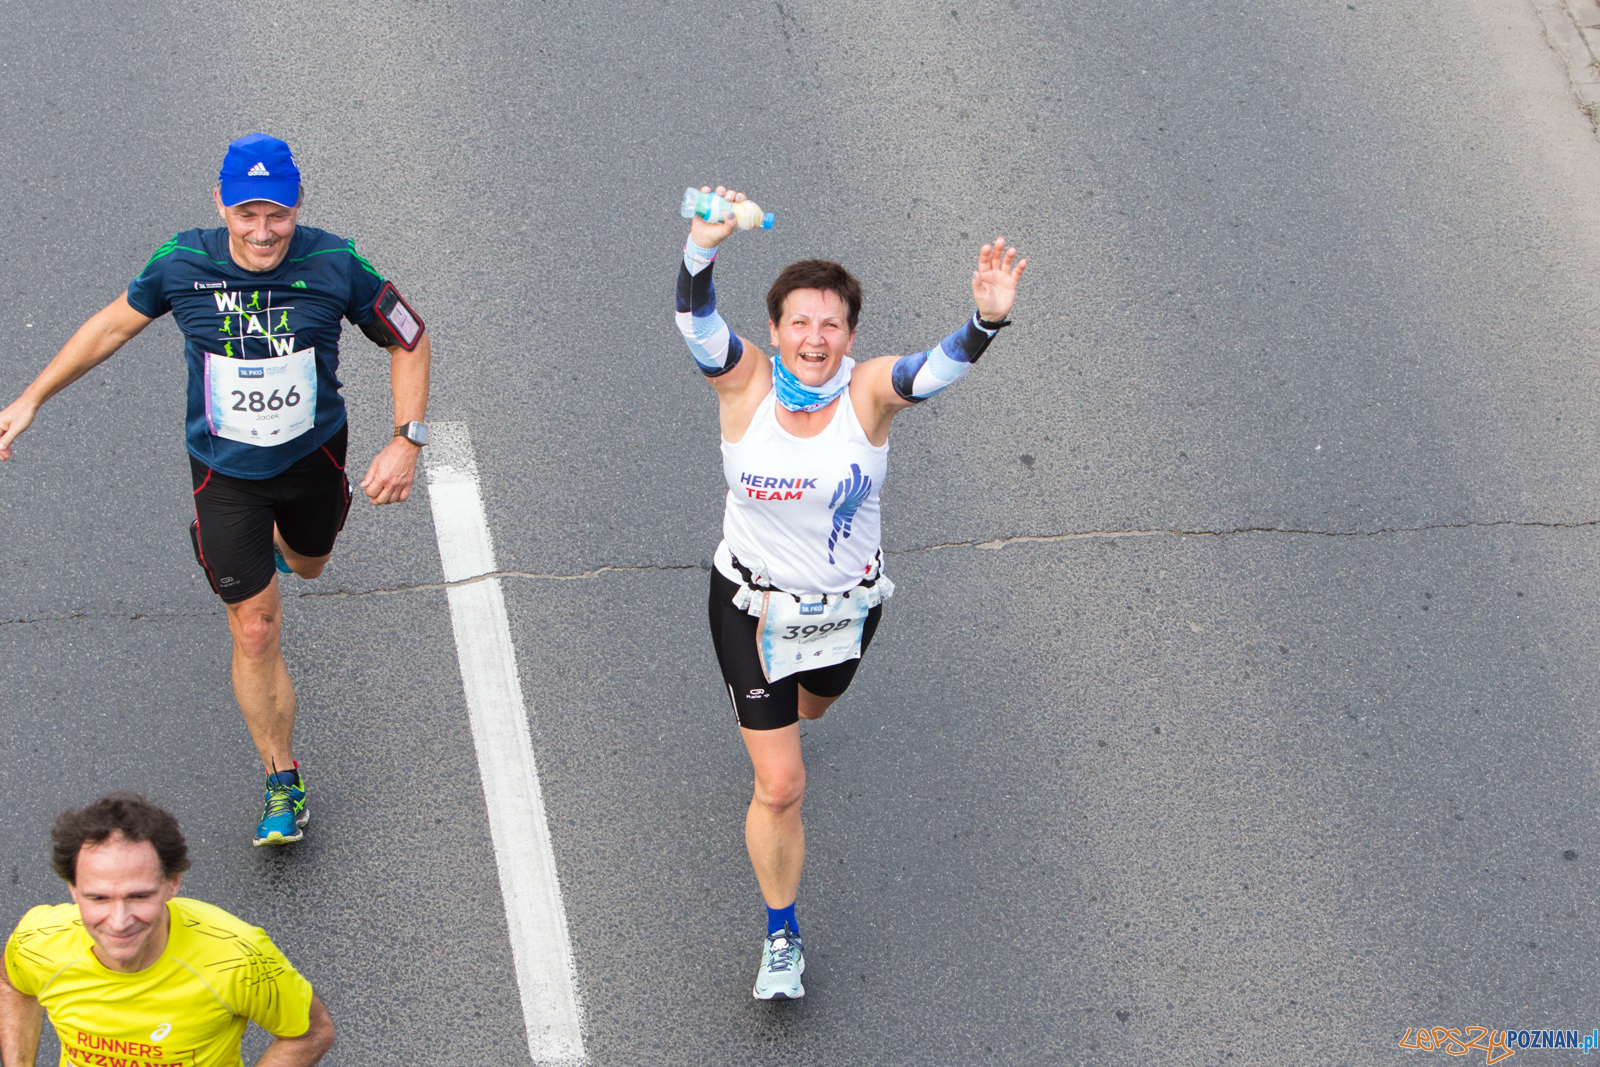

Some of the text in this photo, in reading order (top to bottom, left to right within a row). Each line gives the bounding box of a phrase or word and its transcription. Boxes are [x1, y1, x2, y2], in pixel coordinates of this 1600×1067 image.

[214, 292, 237, 312] W
[246, 314, 263, 334] A
[272, 337, 295, 356] W
[231, 384, 300, 412] 2866
[740, 472, 818, 490] HERNIK
[746, 487, 804, 500] TEAM
[782, 618, 852, 640] 3998
[77, 1031, 163, 1059] RUNNER'S
